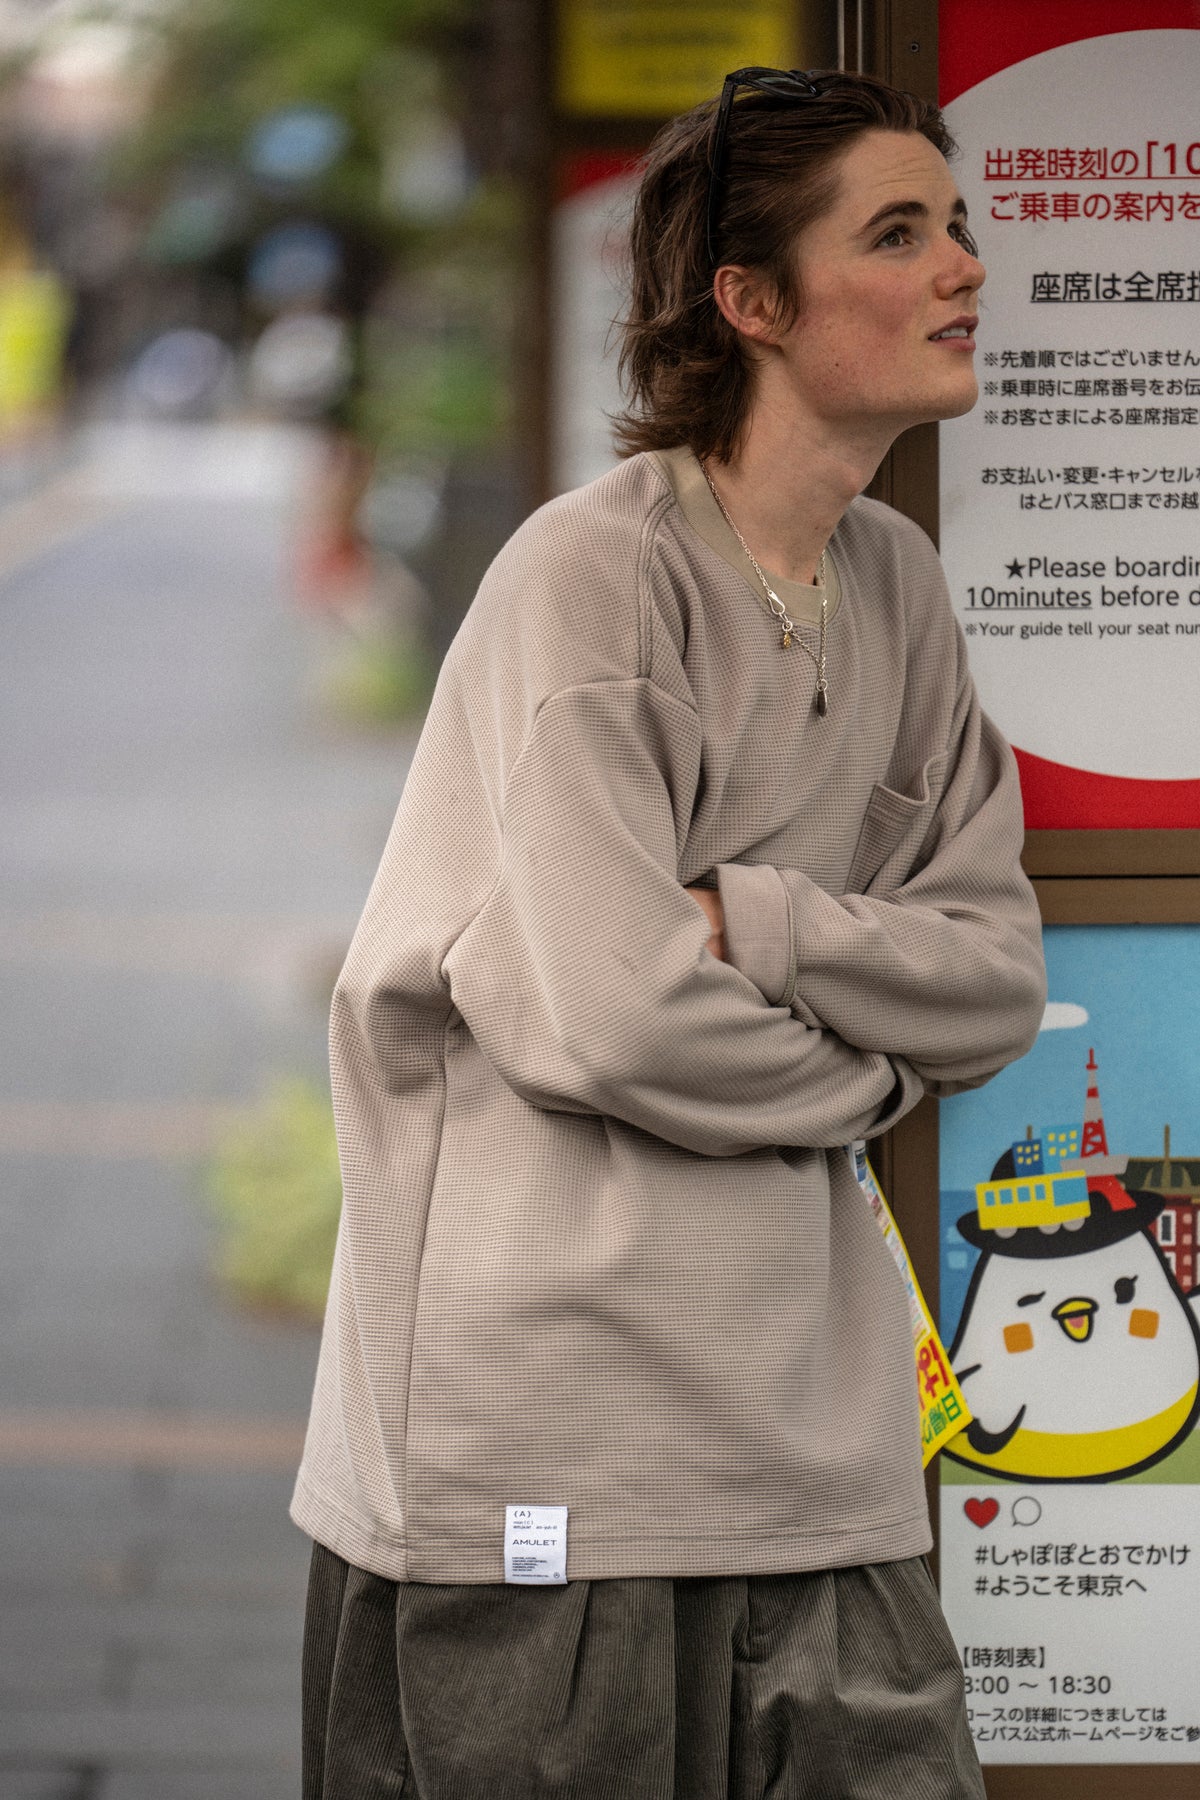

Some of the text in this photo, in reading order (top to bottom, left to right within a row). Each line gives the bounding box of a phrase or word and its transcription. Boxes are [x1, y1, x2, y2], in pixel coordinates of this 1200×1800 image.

[990, 191, 1200, 222] ご乗車の案内を
[967, 586, 1092, 609] 10minutes
[1101, 585, 1180, 607] before
[1020, 621, 1063, 639] guide
[1068, 622, 1093, 636] tell
[1098, 624, 1132, 639] your
[1138, 622, 1170, 635] seat
[975, 1543, 1191, 1566] #しゃぽぽとおでかけ
[975, 1575, 1147, 1597] #ようこそ東京へ
[1049, 1675, 1112, 1694] 18:30
